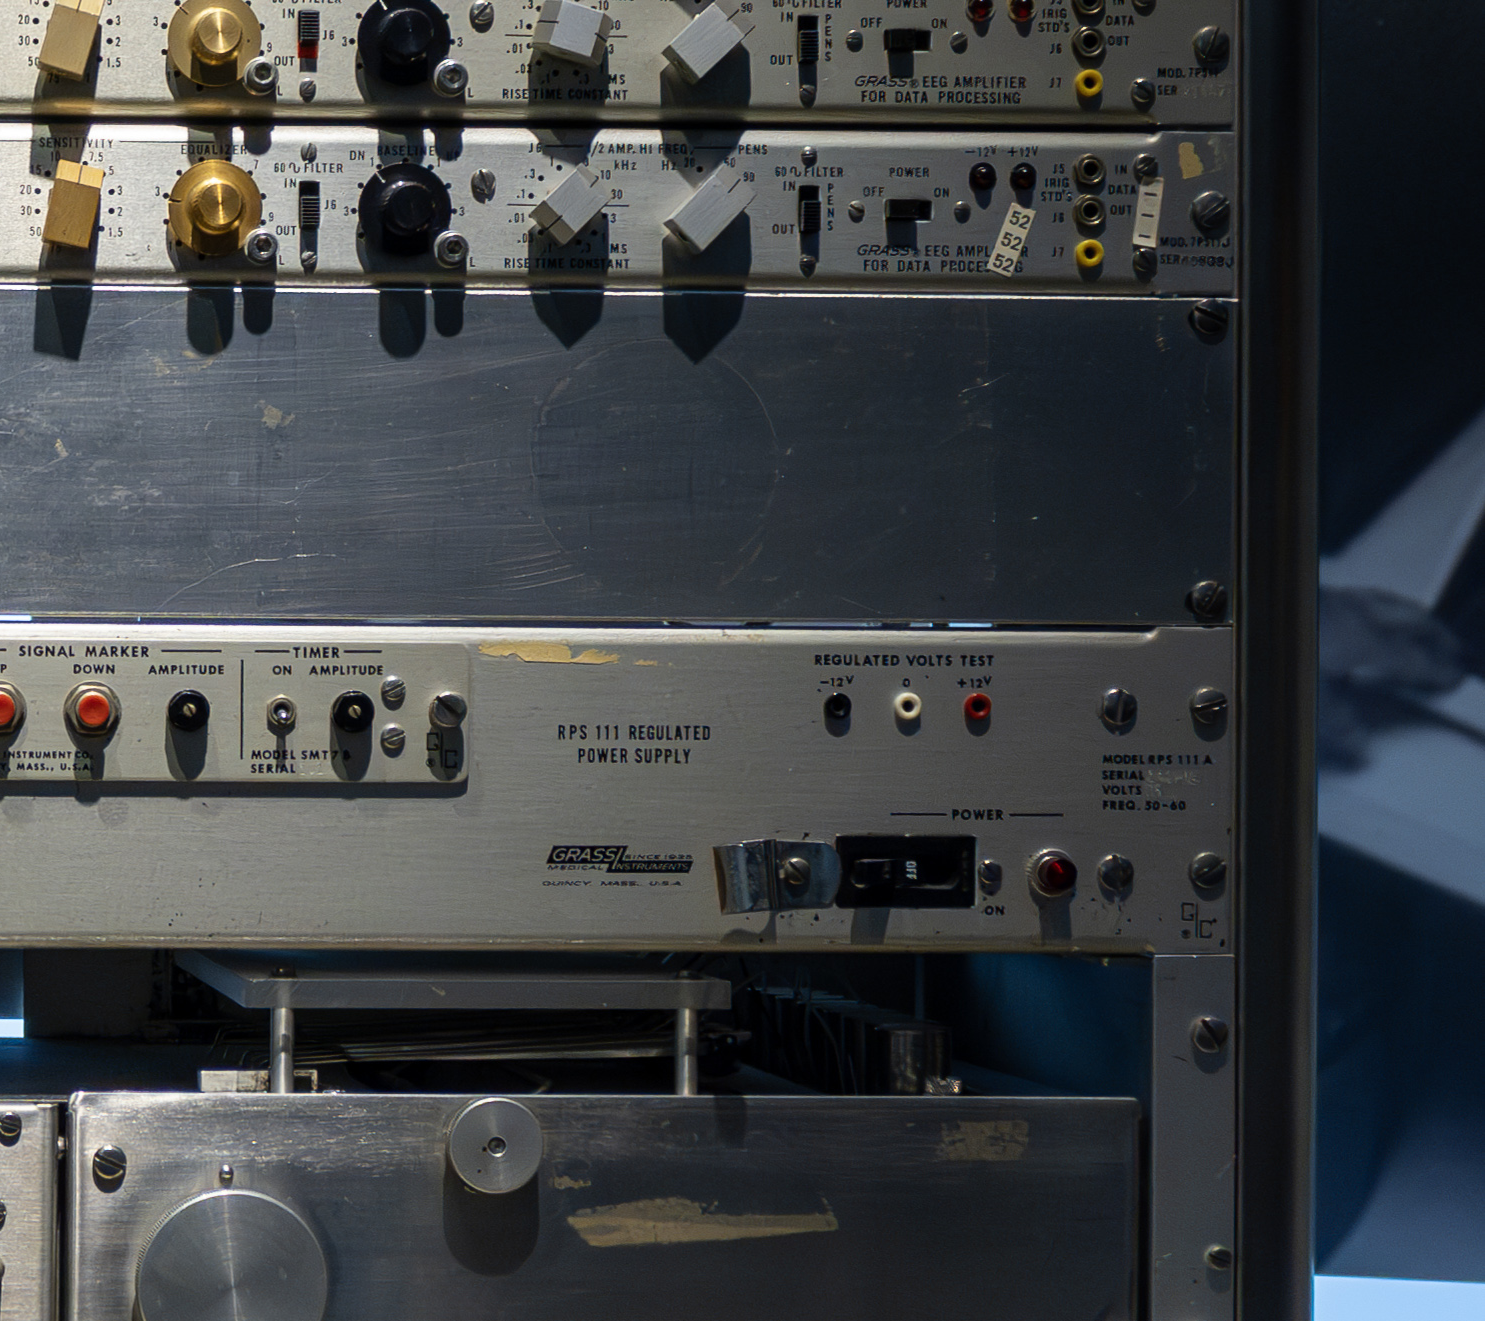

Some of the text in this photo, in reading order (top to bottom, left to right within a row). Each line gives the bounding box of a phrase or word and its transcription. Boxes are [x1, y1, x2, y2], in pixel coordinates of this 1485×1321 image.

[860, 91, 1021, 105] FOR DATA PROCESSING
[1009, 210, 1031, 230] 52
[1000, 231, 1023, 252] 52
[992, 252, 1015, 273] 52
[18, 644, 151, 660] SIGNAL MARKER
[292, 645, 343, 660] TIMER
[813, 654, 995, 667] REGULATED VOLTS TEST
[72, 662, 118, 676] DOWN
[147, 663, 226, 677] AMPLITUDE
[271, 664, 295, 677] ON
[308, 664, 385, 678] AMPLITUDE
[627, 725, 712, 742] REGULATED
[3, 749, 71, 761] INSTRUMENT
[250, 749, 298, 762] MODEL
[577, 748, 691, 766] POWER SUPPLY
[1102, 753, 1146, 766] MODEL
[1101, 784, 1142, 796] VOLTS
[951, 808, 1005, 822] POWER
[552, 847, 616, 862] GRASS
[983, 904, 1006, 917] ON
